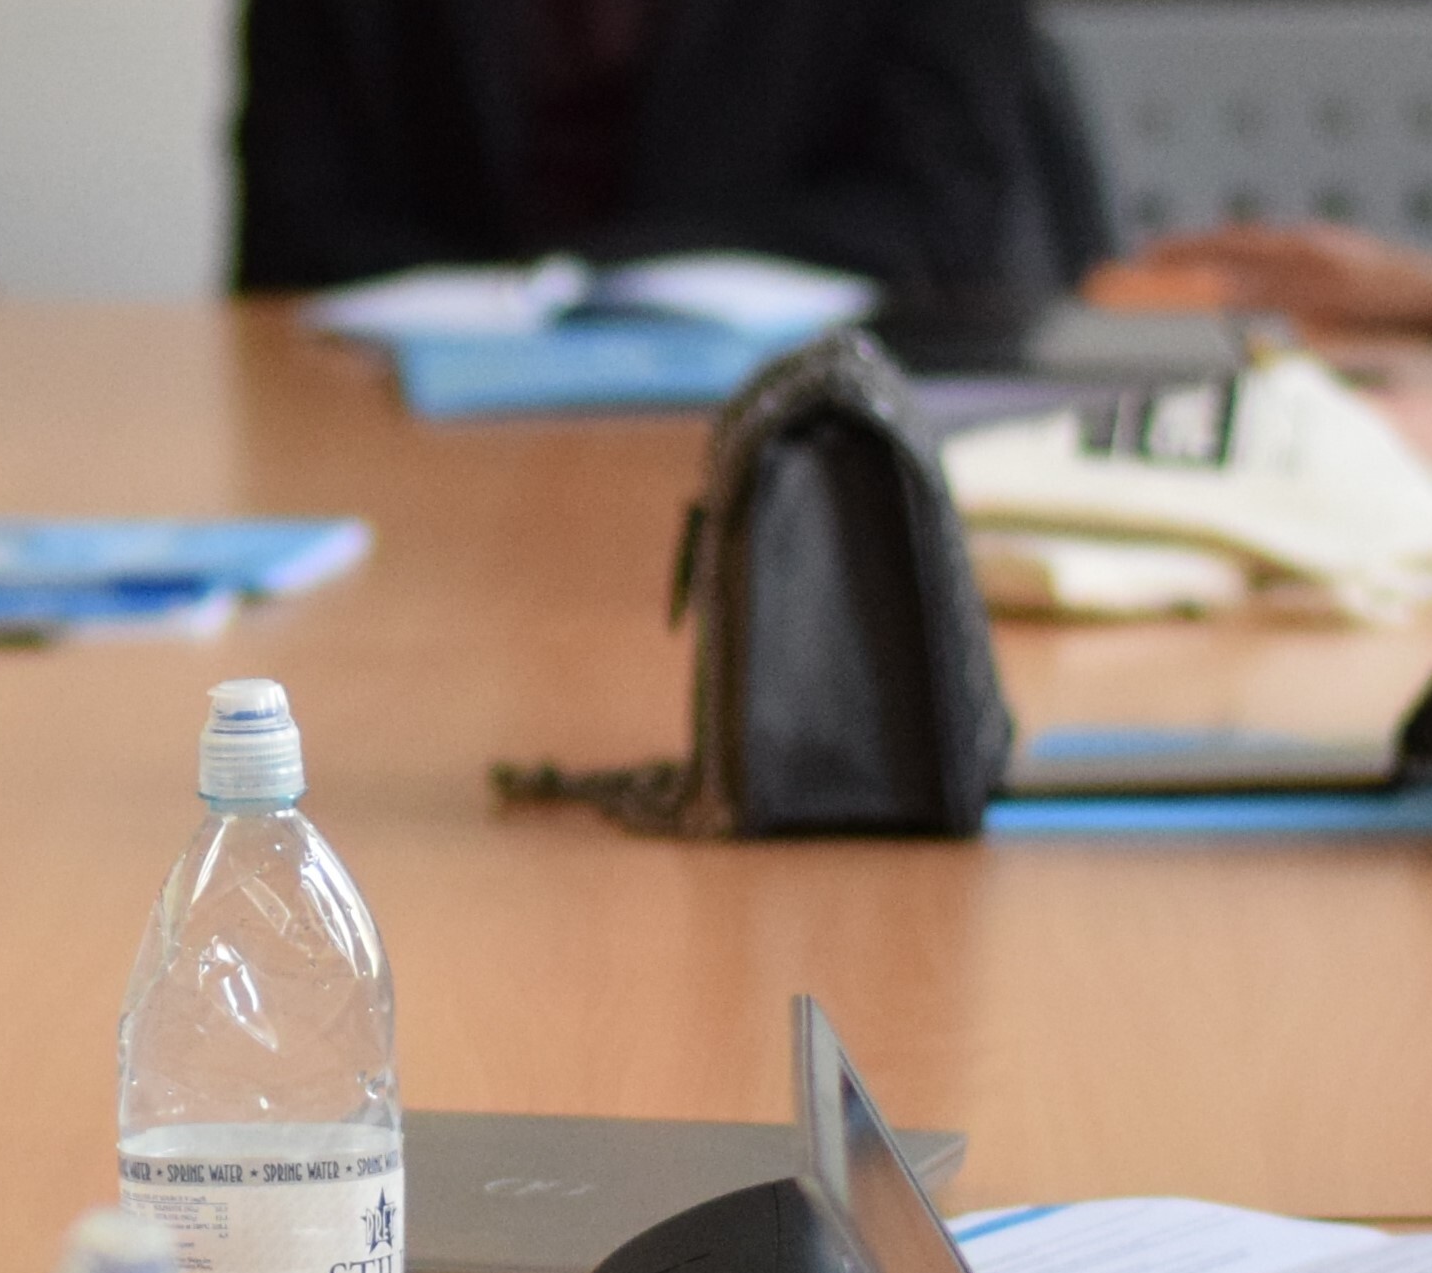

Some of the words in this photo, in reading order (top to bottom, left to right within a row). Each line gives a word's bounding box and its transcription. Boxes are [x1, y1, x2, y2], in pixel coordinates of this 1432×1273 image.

[167, 1163, 205, 1183] SPRING
[208, 1163, 243, 1183] WATER
[263, 1162, 303, 1183] SPRING
[306, 1160, 340, 1181] WATER
